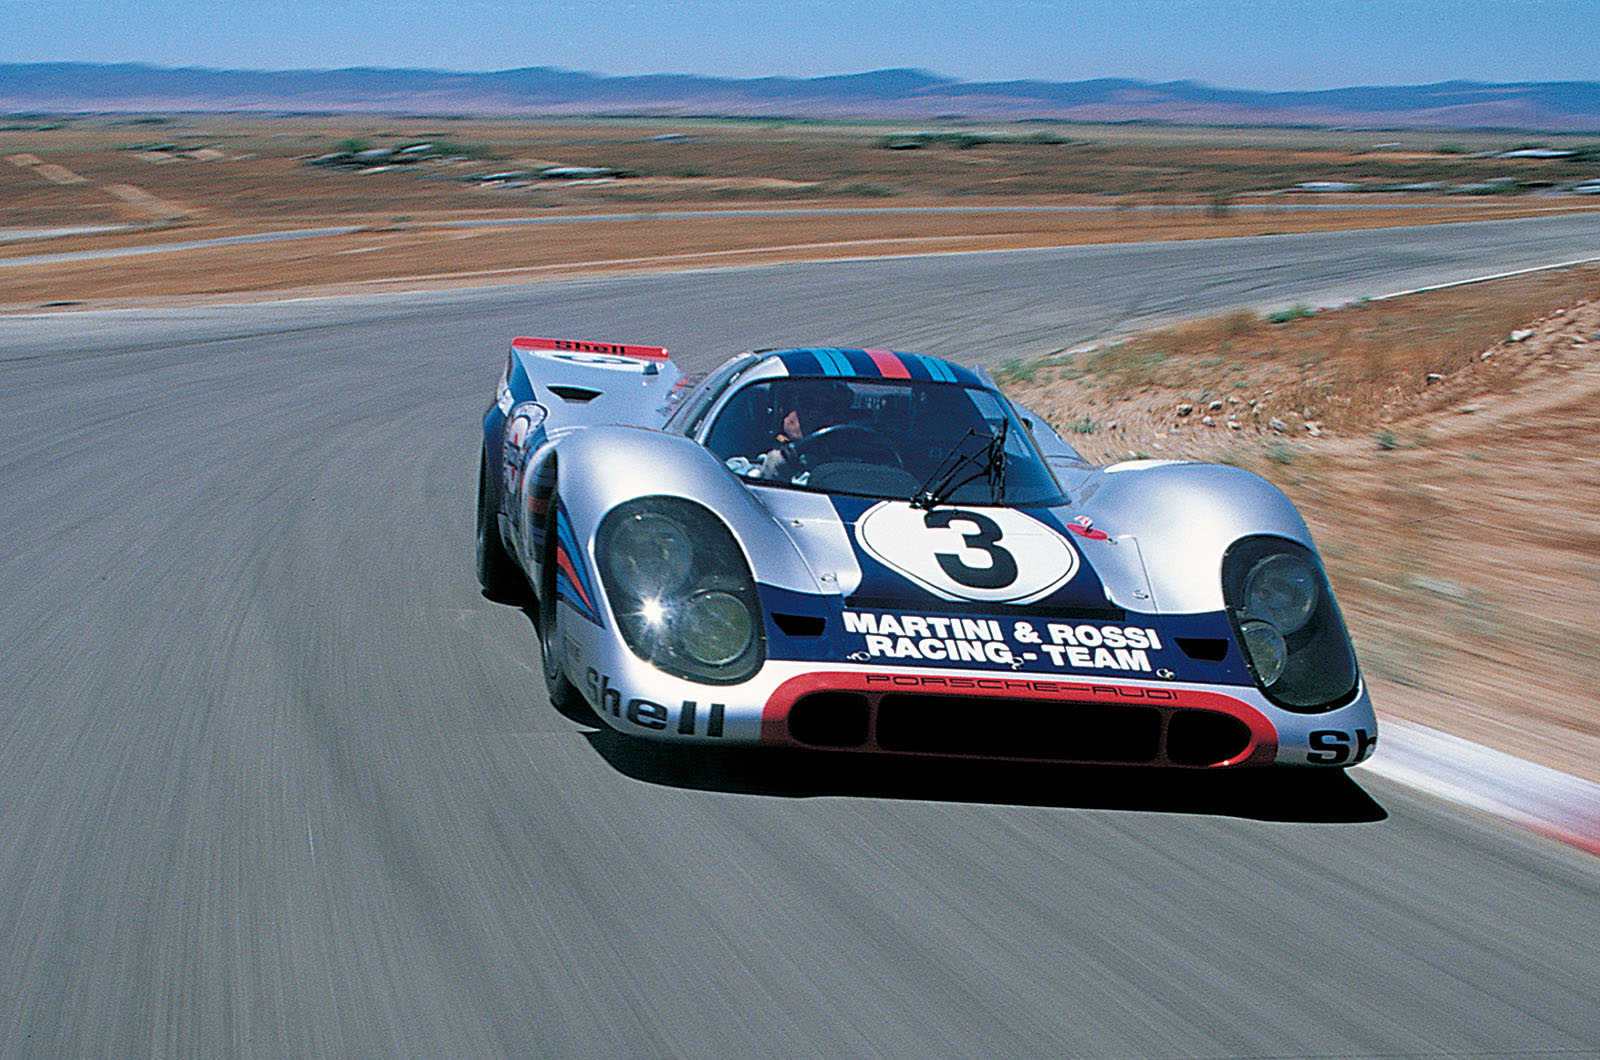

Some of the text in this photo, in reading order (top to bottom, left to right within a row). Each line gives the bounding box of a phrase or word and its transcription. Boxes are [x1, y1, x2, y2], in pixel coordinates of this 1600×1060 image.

[554, 340, 625, 356] Shell
[923, 509, 1019, 590] 3
[842, 611, 1162, 650] MARTINI & ROSSI
[865, 634, 1014, 664] RACING
[1041, 644, 1152, 672] TEAM
[586, 666, 726, 738] Shell
